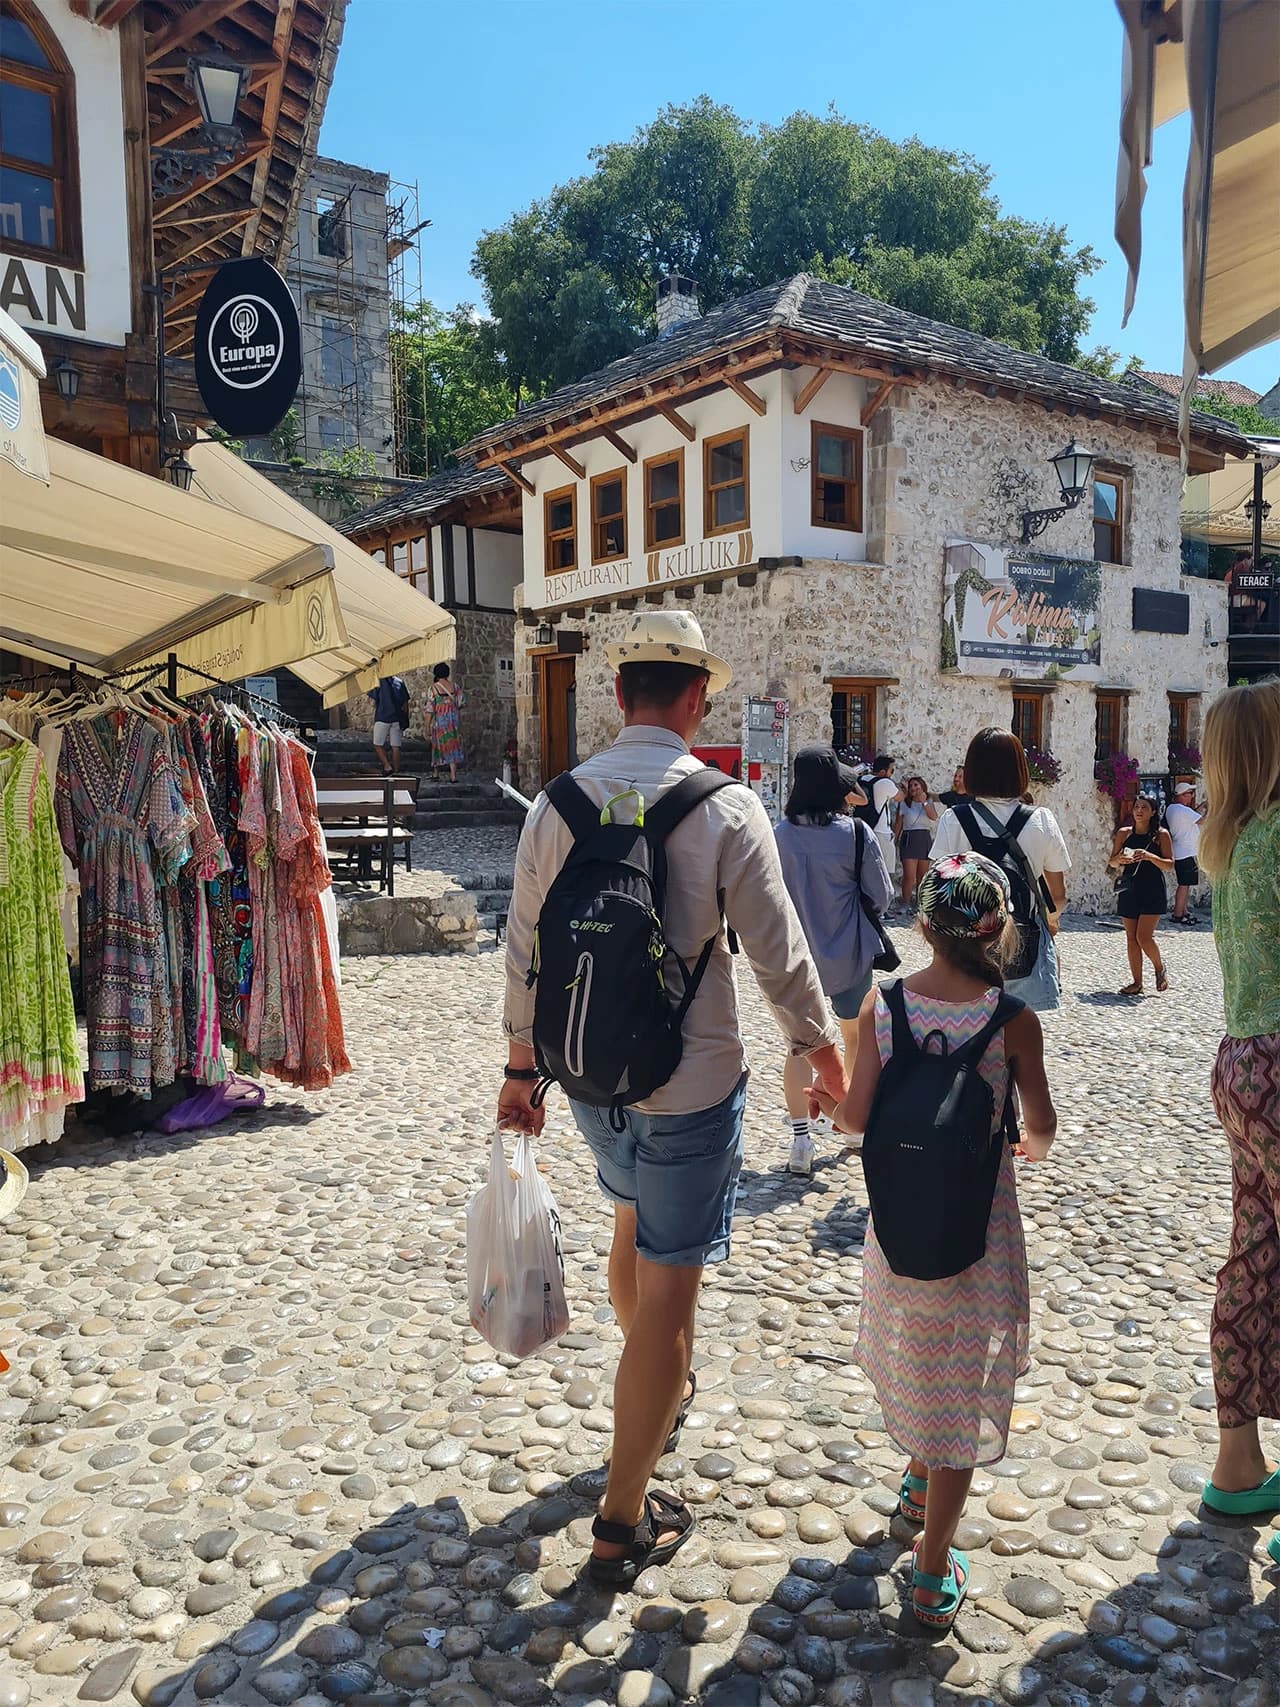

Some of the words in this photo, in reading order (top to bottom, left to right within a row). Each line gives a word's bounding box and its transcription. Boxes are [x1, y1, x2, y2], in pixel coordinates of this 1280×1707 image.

[0, 258, 86, 331] AN
[220, 344, 275, 363] Europa
[545, 561, 632, 603] RESTAURANT
[665, 541, 735, 579] KULLUK
[1011, 566, 1032, 575] DOBRO
[1239, 576, 1270, 586] TERACE
[902, 1503, 925, 1518] croc
[915, 1610, 950, 1624] crocs
